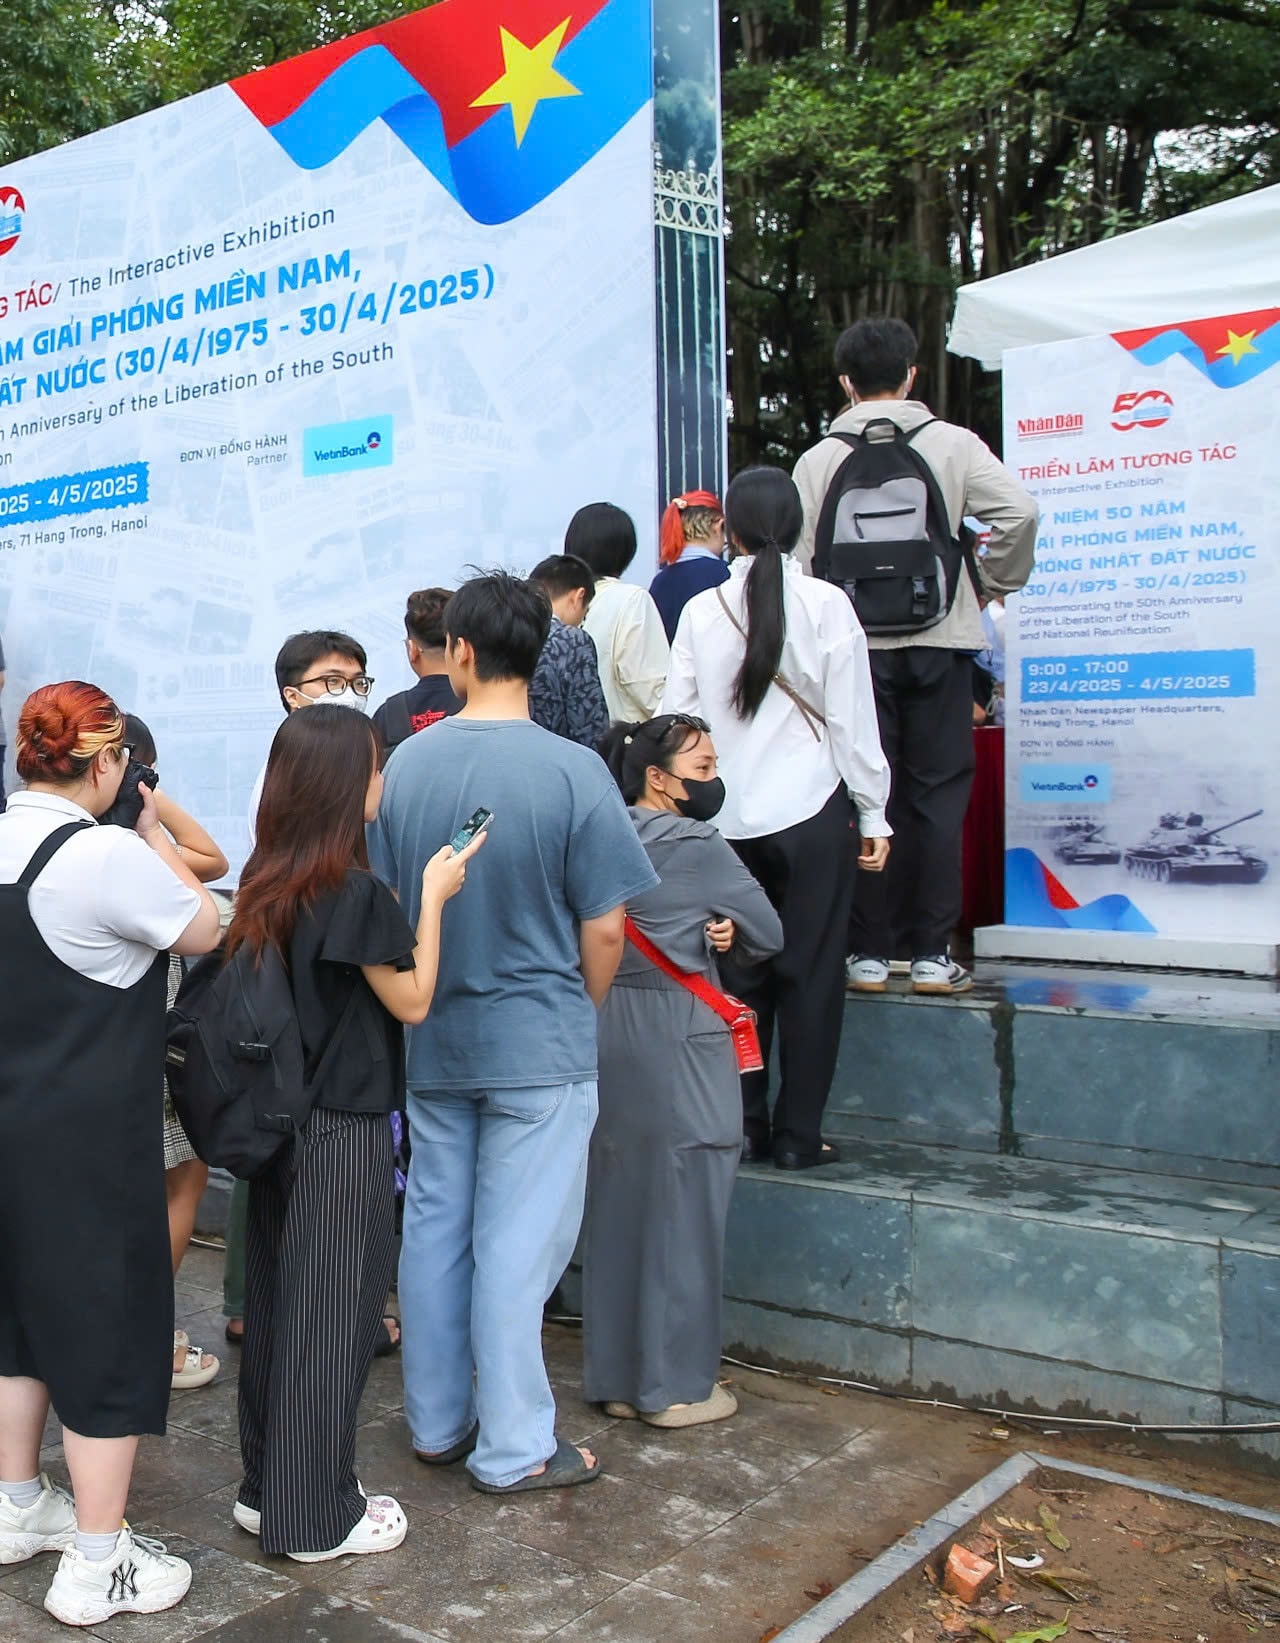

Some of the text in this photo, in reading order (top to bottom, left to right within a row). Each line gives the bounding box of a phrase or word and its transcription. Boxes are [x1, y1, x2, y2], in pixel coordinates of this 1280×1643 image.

[68, 274, 101, 297] The
[109, 239, 214, 287] Interactive
[223, 208, 335, 252] Exhibition
[33, 315, 81, 355] GIẢI
[91, 294, 183, 341] PHÓNG
[195, 268, 266, 314] MIỀN
[278, 249, 360, 293] NAM,
[37, 355, 106, 398] NƯỚC
[115, 318, 268, 380] (30/4/1975
[300, 264, 495, 336] 30/4/2025)
[10, 406, 103, 439] Anniversary
[109, 398, 125, 417] of
[131, 391, 158, 413] the
[164, 372, 257, 405] Liberation
[265, 364, 284, 385] of
[291, 357, 324, 378] the
[332, 343, 393, 371] South
[247, 453, 288, 466] Partner
[313, 444, 368, 461] VietinBank
[1019, 442, 1237, 481] TRIỂN LÃM TƯƠNG TÁC
[47, 474, 138, 508] 4/5/2025
[1041, 483, 1101, 496] Interactive
[1105, 477, 1164, 491] Exhibition
[1106, 506, 1132, 520] 50
[19, 534, 30, 547] 71
[34, 527, 65, 546] Hang
[70, 520, 107, 540] Trong,
[111, 515, 148, 534] Hanoi
[1190, 520, 1244, 538] NAM,
[1134, 569, 1246, 590] 30/4/2025)
[1020, 594, 1243, 614] Commemorating the 50th Anniversary
[1020, 610, 1190, 627] of the Liberation of the South
[1020, 624, 1171, 640] and National Reunification
[1028, 663, 1066, 676] 9:00
[1084, 660, 1129, 675] 17:00
[1028, 679, 1121, 694] 23/4/2025
[1140, 676, 1231, 691] 4/5/2025
[1020, 707, 1047, 716] Nhan
[1051, 706, 1071, 716] Dan
[1075, 706, 1136, 718] Newspaper
[1033, 719, 1061, 729] Hang
[1102, 717, 1135, 727] Hanoi
[1031, 781, 1086, 792] VietinBank
